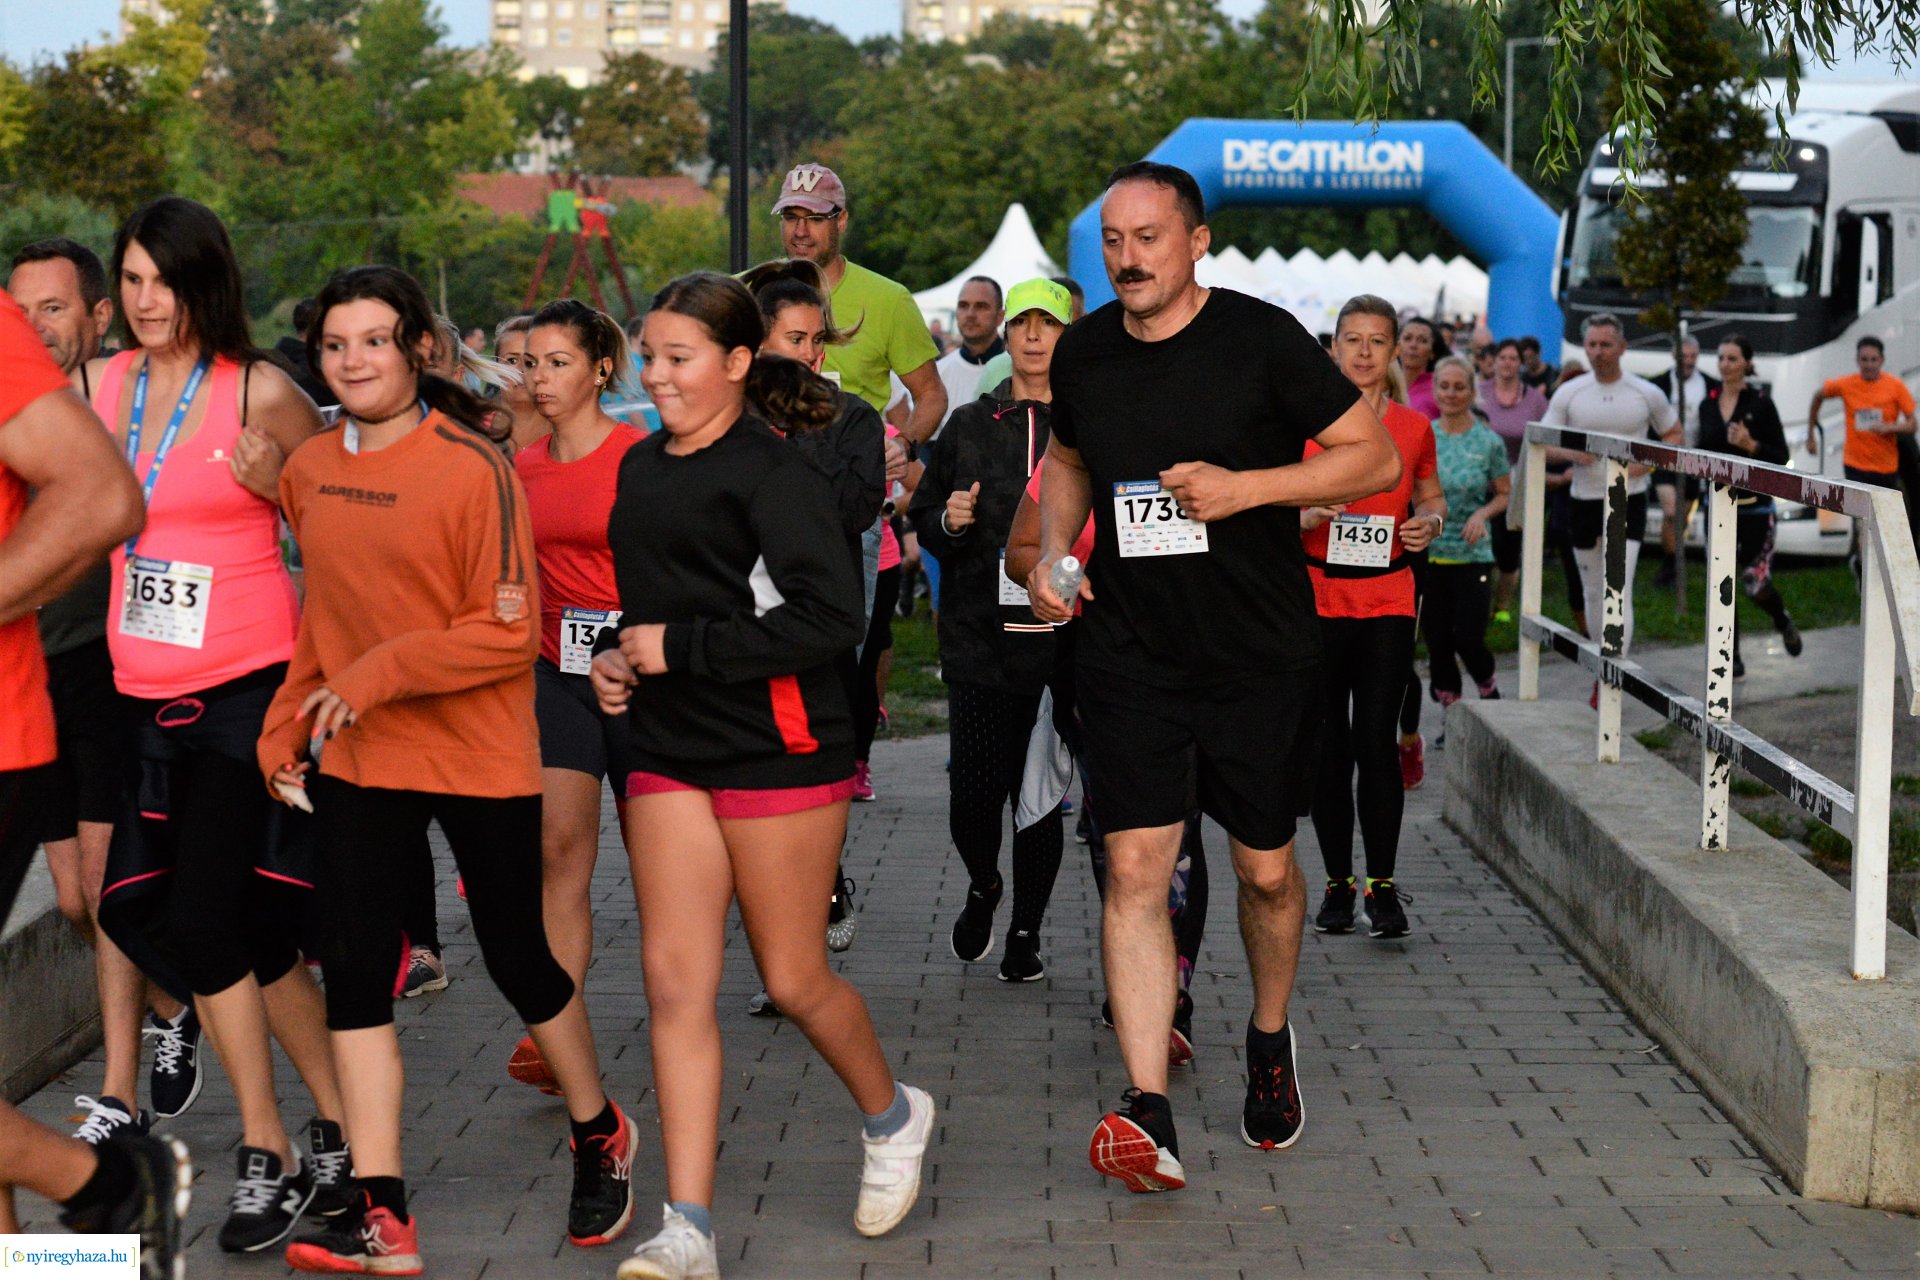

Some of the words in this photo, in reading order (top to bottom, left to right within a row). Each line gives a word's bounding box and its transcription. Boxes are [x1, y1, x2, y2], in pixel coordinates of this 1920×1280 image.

[1223, 139, 1424, 173] DECATHLON
[791, 169, 823, 193] W
[319, 484, 398, 503] AGRESSOR
[1335, 524, 1388, 545] 1430
[132, 573, 199, 608] 1633
